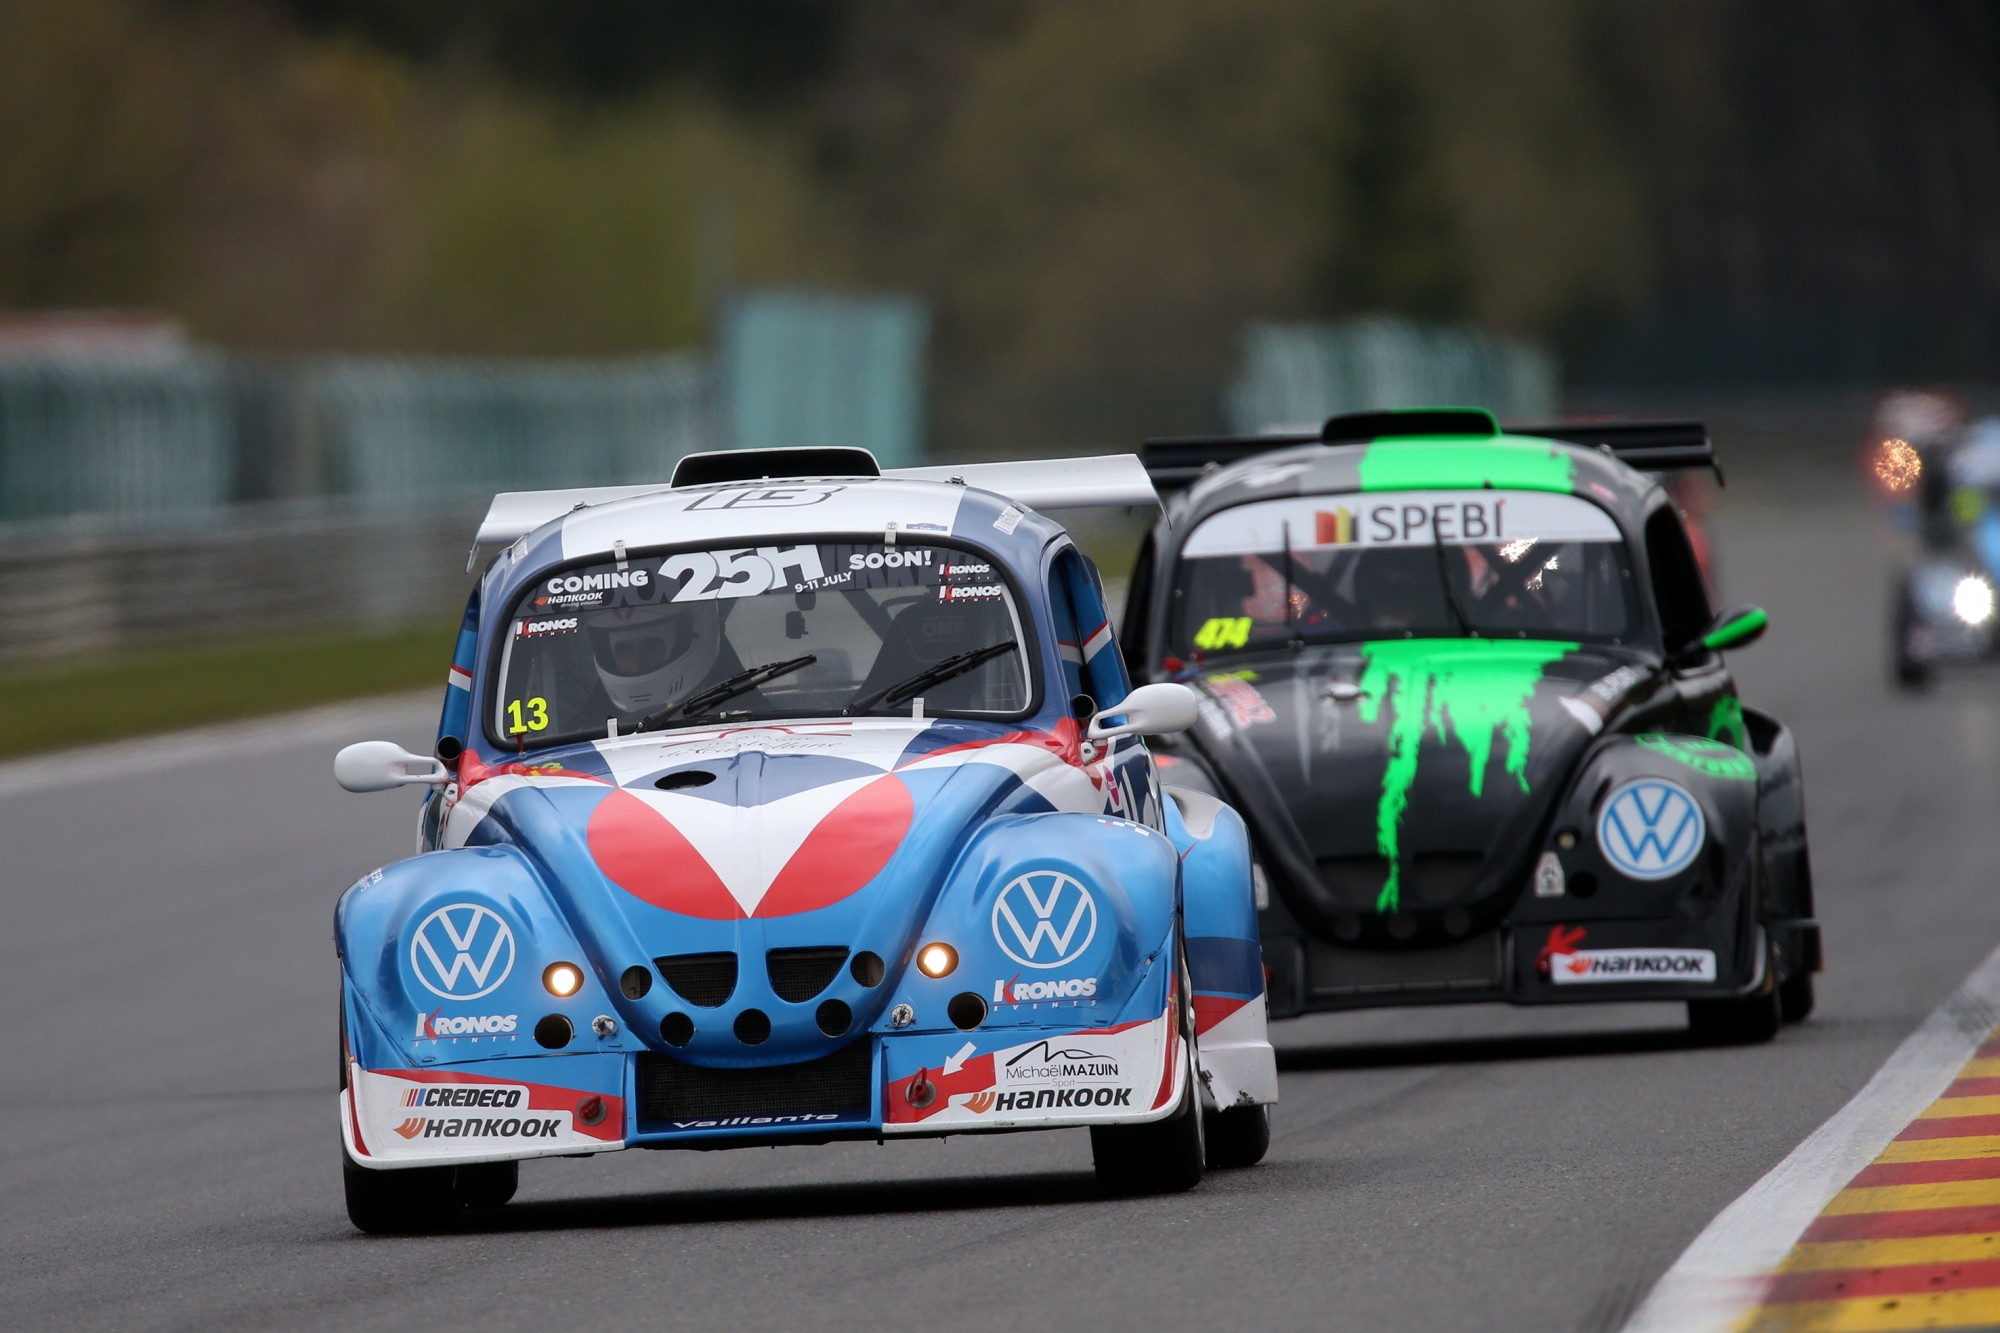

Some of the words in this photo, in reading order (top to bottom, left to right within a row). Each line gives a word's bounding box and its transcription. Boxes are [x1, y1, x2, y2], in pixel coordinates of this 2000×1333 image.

[849, 550, 932, 570] SOON!
[939, 562, 990, 576] KRONOS
[547, 570, 649, 594] COMING
[657, 545, 825, 603] 25H
[795, 578, 820, 593] 9-11
[822, 571, 853, 588] JULY
[939, 583, 1002, 600] KRONOS
[516, 617, 578, 636] KRONOS
[507, 697, 549, 734] 13
[993, 972, 1097, 1004] KRONOS
[415, 1006, 518, 1038] KRONOS
[1052, 1078, 1076, 1088] Sport
[424, 1088, 522, 1108] CREDECO
[673, 1113, 839, 1129] Vaillante
